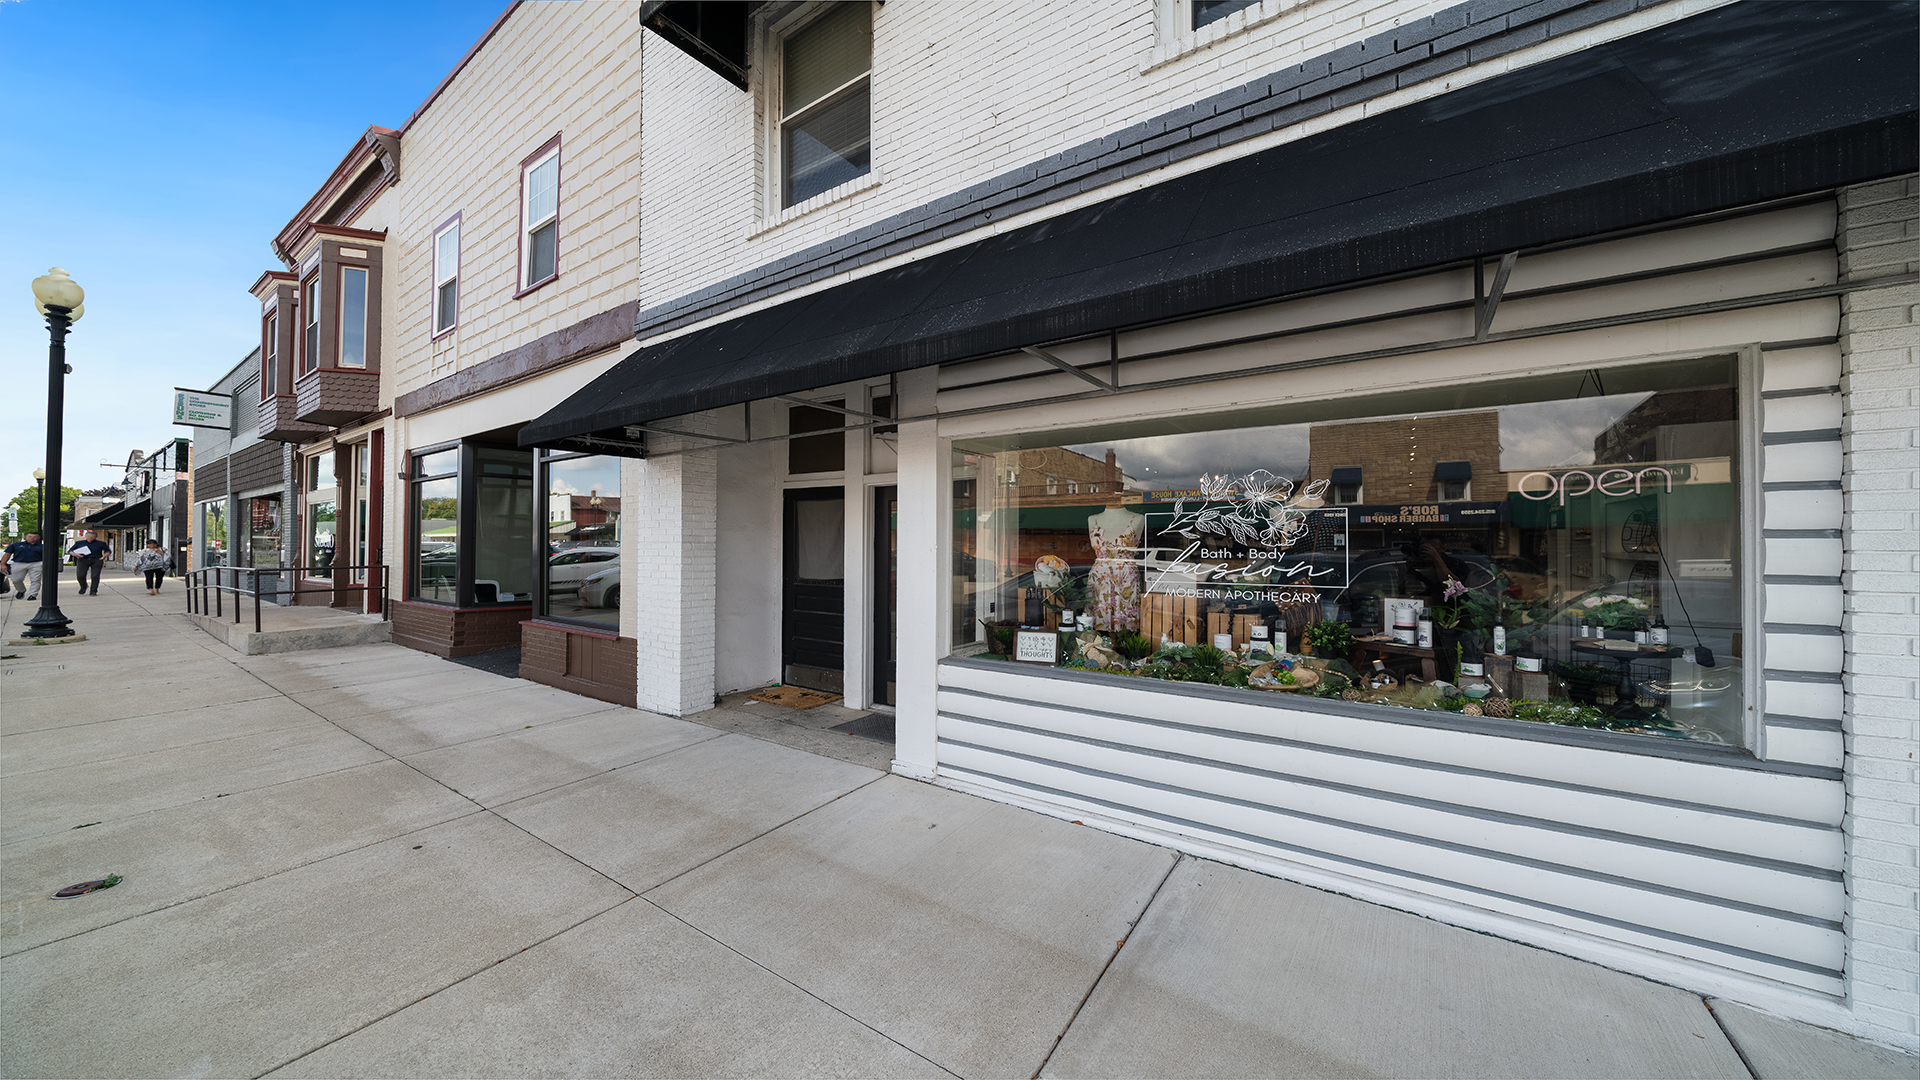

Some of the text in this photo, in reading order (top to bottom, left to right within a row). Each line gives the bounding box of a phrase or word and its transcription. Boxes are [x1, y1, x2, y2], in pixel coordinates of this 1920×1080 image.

[1518, 466, 1672, 507] open
[1144, 540, 1334, 598] fusion
[1201, 548, 1231, 559] Bath
[1249, 548, 1286, 562] Body
[1165, 588, 1322, 604] MODERN APOTHECARY
